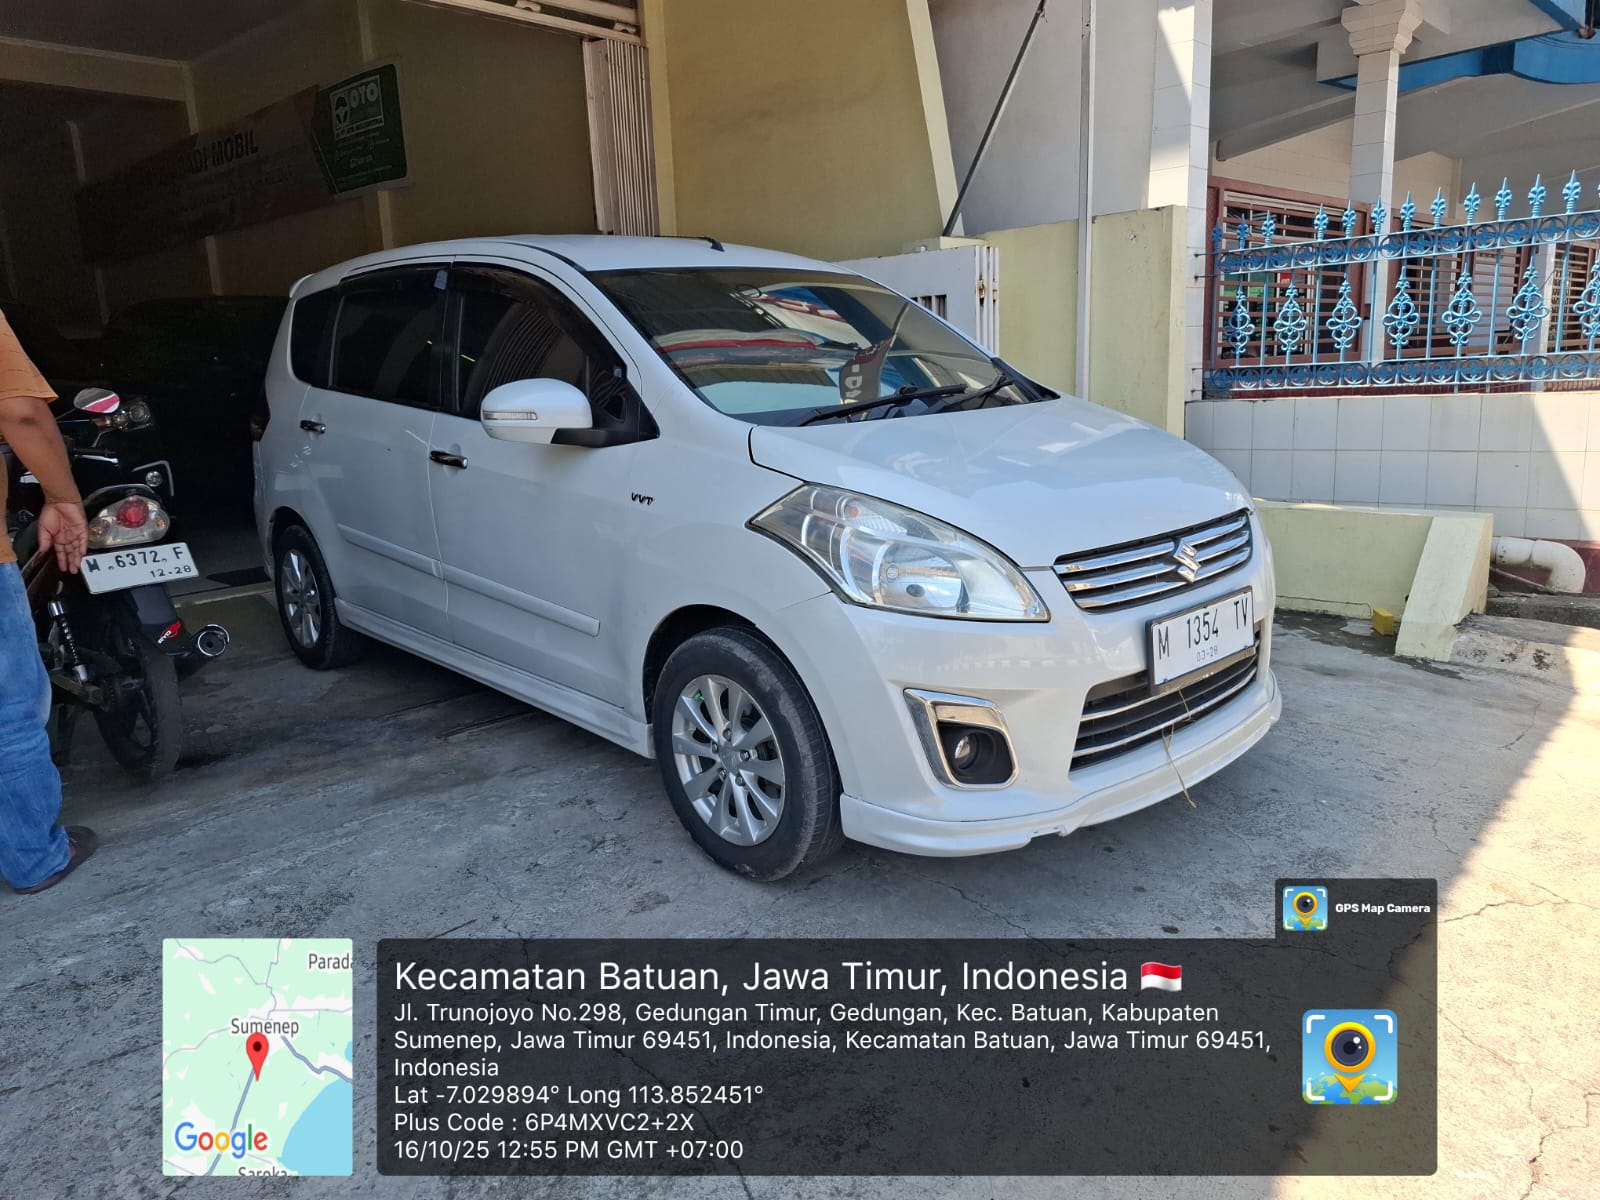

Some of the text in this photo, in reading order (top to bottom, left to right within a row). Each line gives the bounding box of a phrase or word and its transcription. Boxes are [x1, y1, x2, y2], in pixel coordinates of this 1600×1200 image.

[211, 129, 259, 167] MOBIL
[86, 546, 184, 573] M 6372 F
[1158, 597, 1248, 660] M 1354 TV
